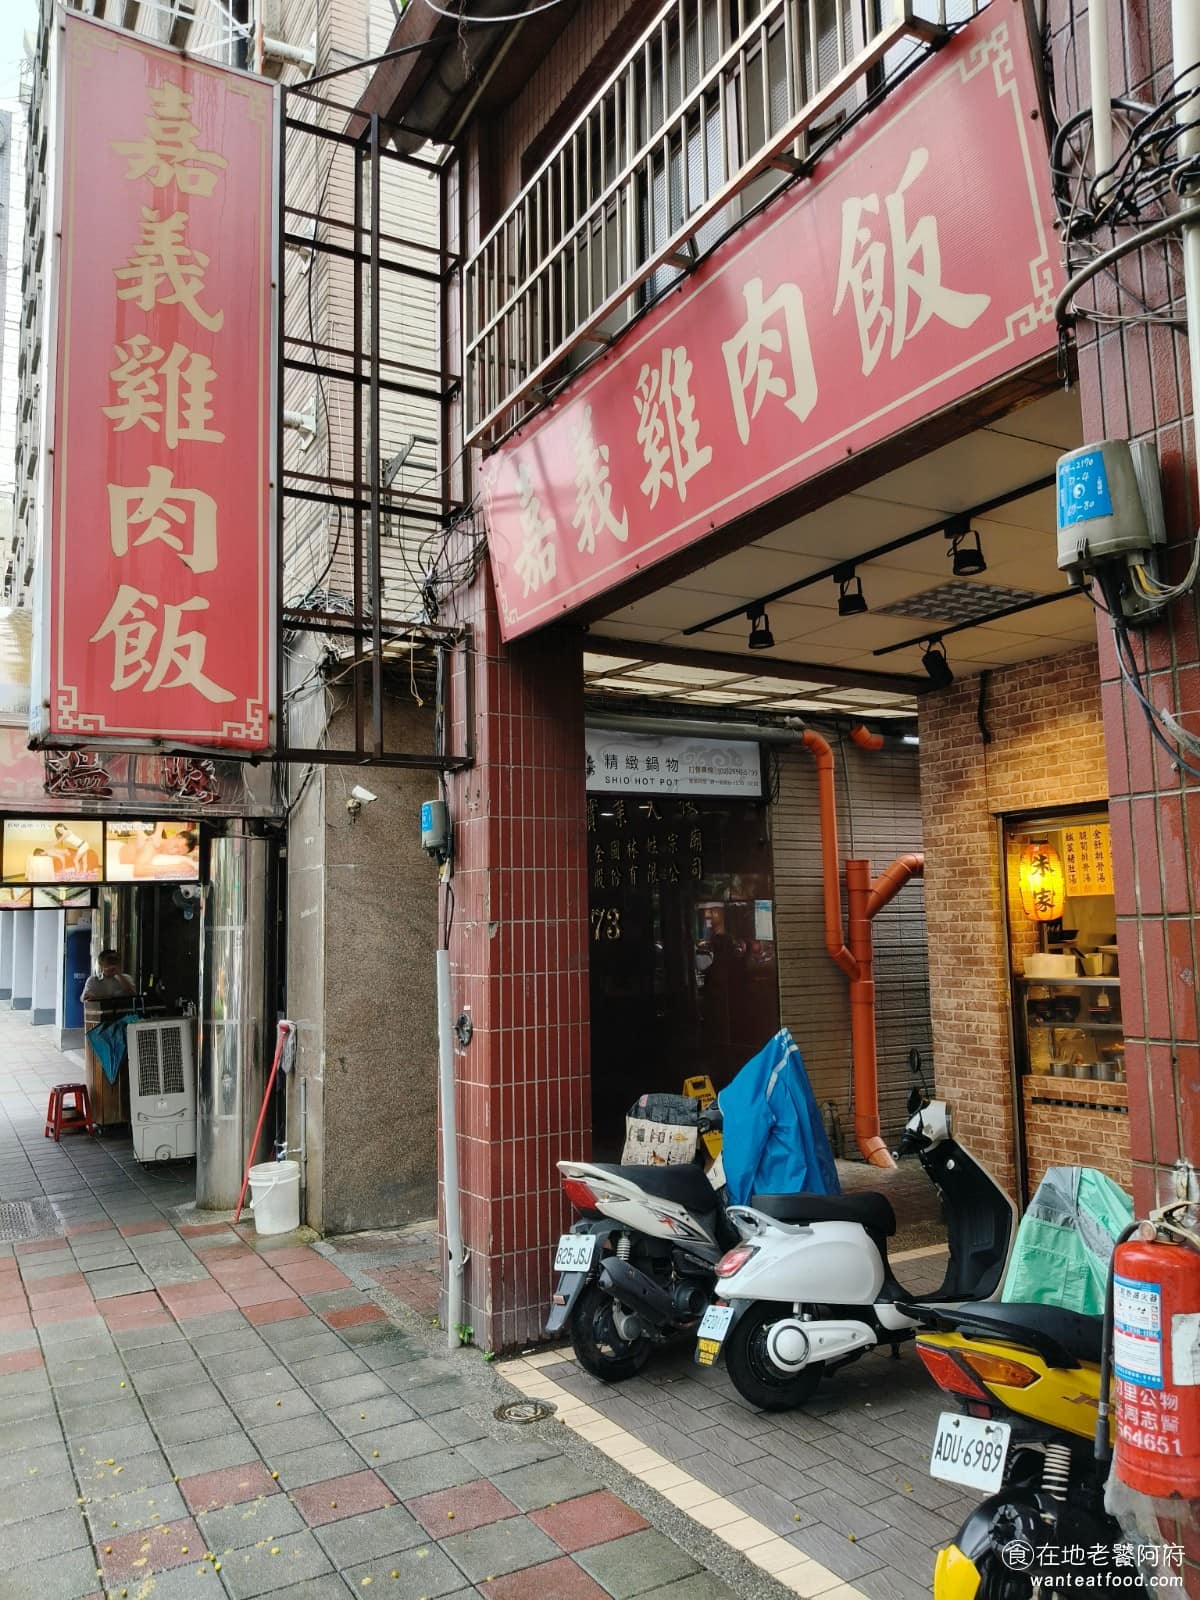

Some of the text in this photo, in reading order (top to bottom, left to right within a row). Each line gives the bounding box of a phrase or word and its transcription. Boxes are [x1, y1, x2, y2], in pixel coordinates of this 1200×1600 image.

[513, 146, 992, 596] 嘉義雞肉飯
[90, 82, 237, 703] 嘉義雞肉飯
[604, 753, 679, 773] 精緻鍋物
[605, 776, 630, 785] SHIO
[634, 777, 655, 786] HOT
[659, 778, 680, 787] POT
[591, 905, 622, 942] 73
